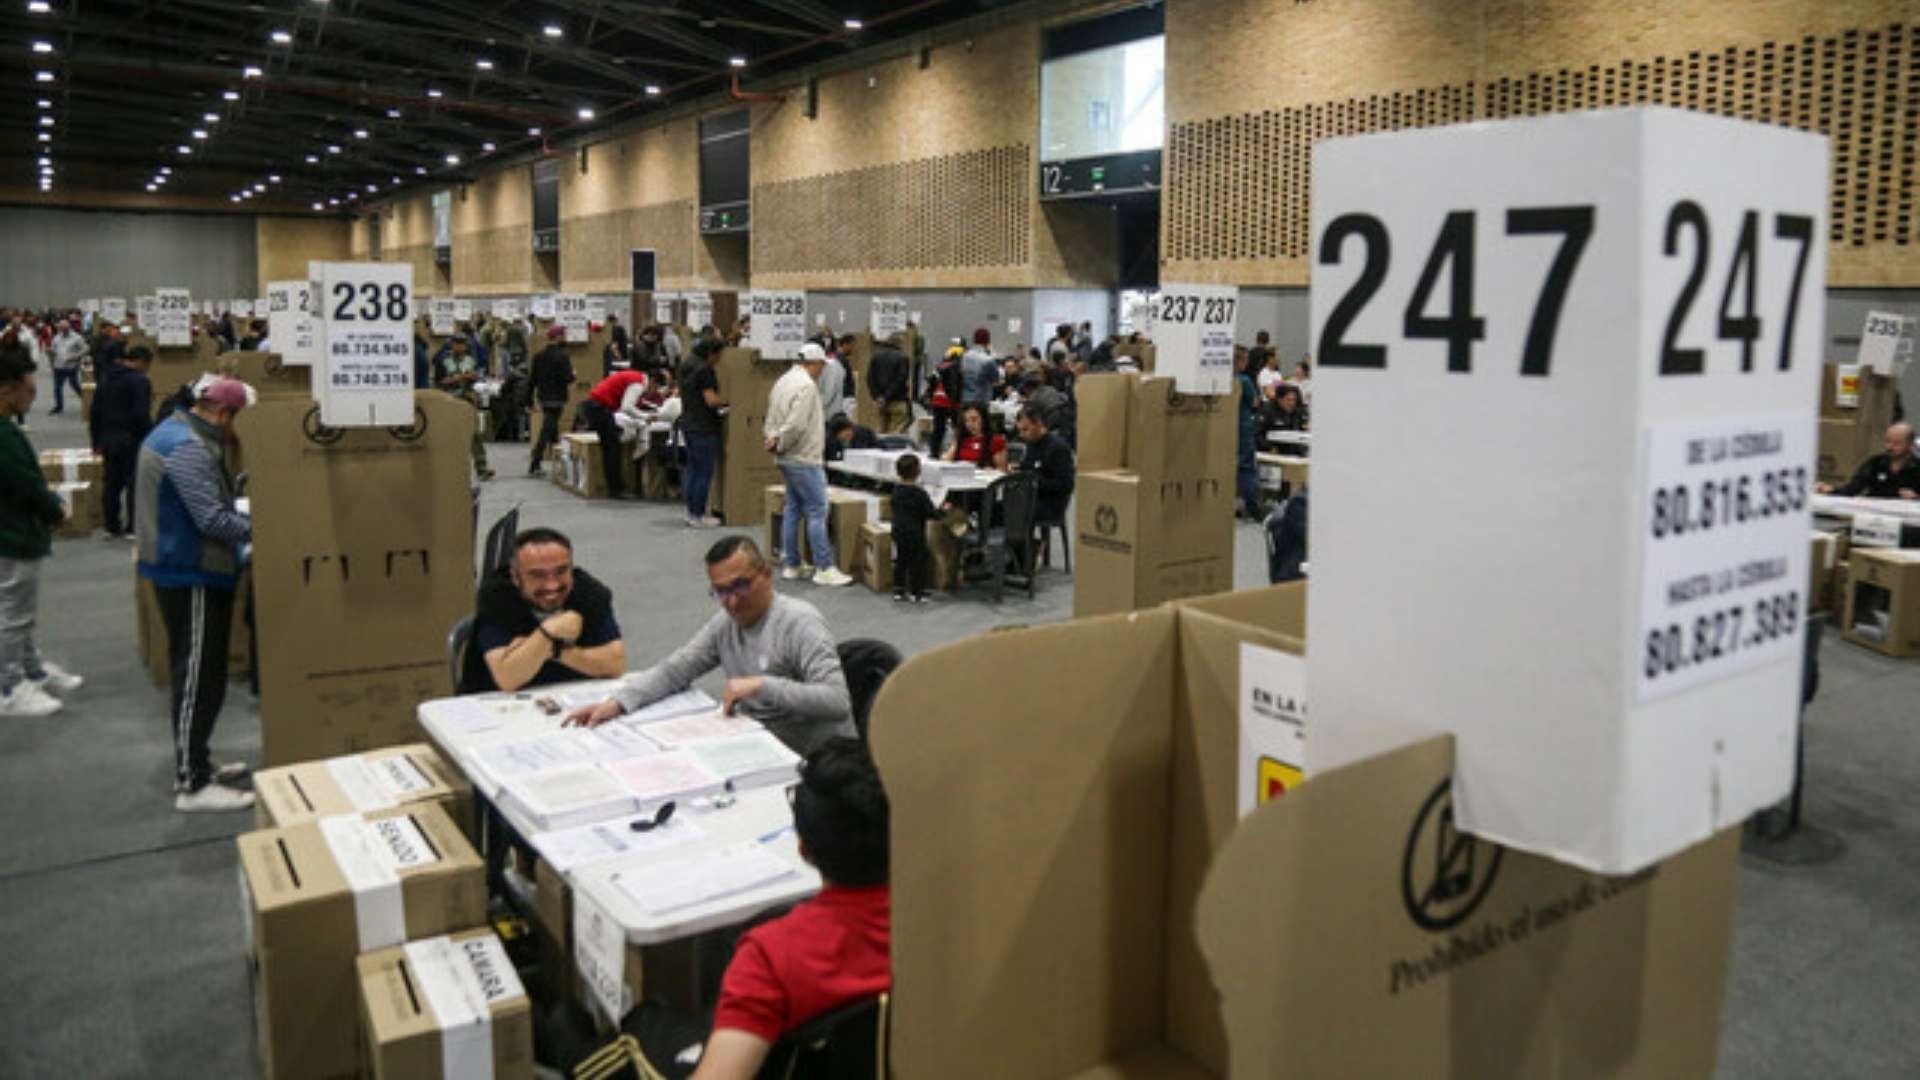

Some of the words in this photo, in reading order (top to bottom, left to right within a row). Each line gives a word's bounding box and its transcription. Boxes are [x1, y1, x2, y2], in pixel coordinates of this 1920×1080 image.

[332, 282, 408, 321] 238
[774, 297, 804, 315] 228
[1317, 205, 1597, 377] 247
[1658, 199, 1815, 377] 247
[1163, 295, 1200, 323] 237
[1204, 298, 1235, 324] 237
[1653, 467, 1806, 538] 80.816.353
[1646, 592, 1797, 678] 80.827.389
[1252, 687, 1274, 705] EN
[1277, 693, 1297, 712] LA
